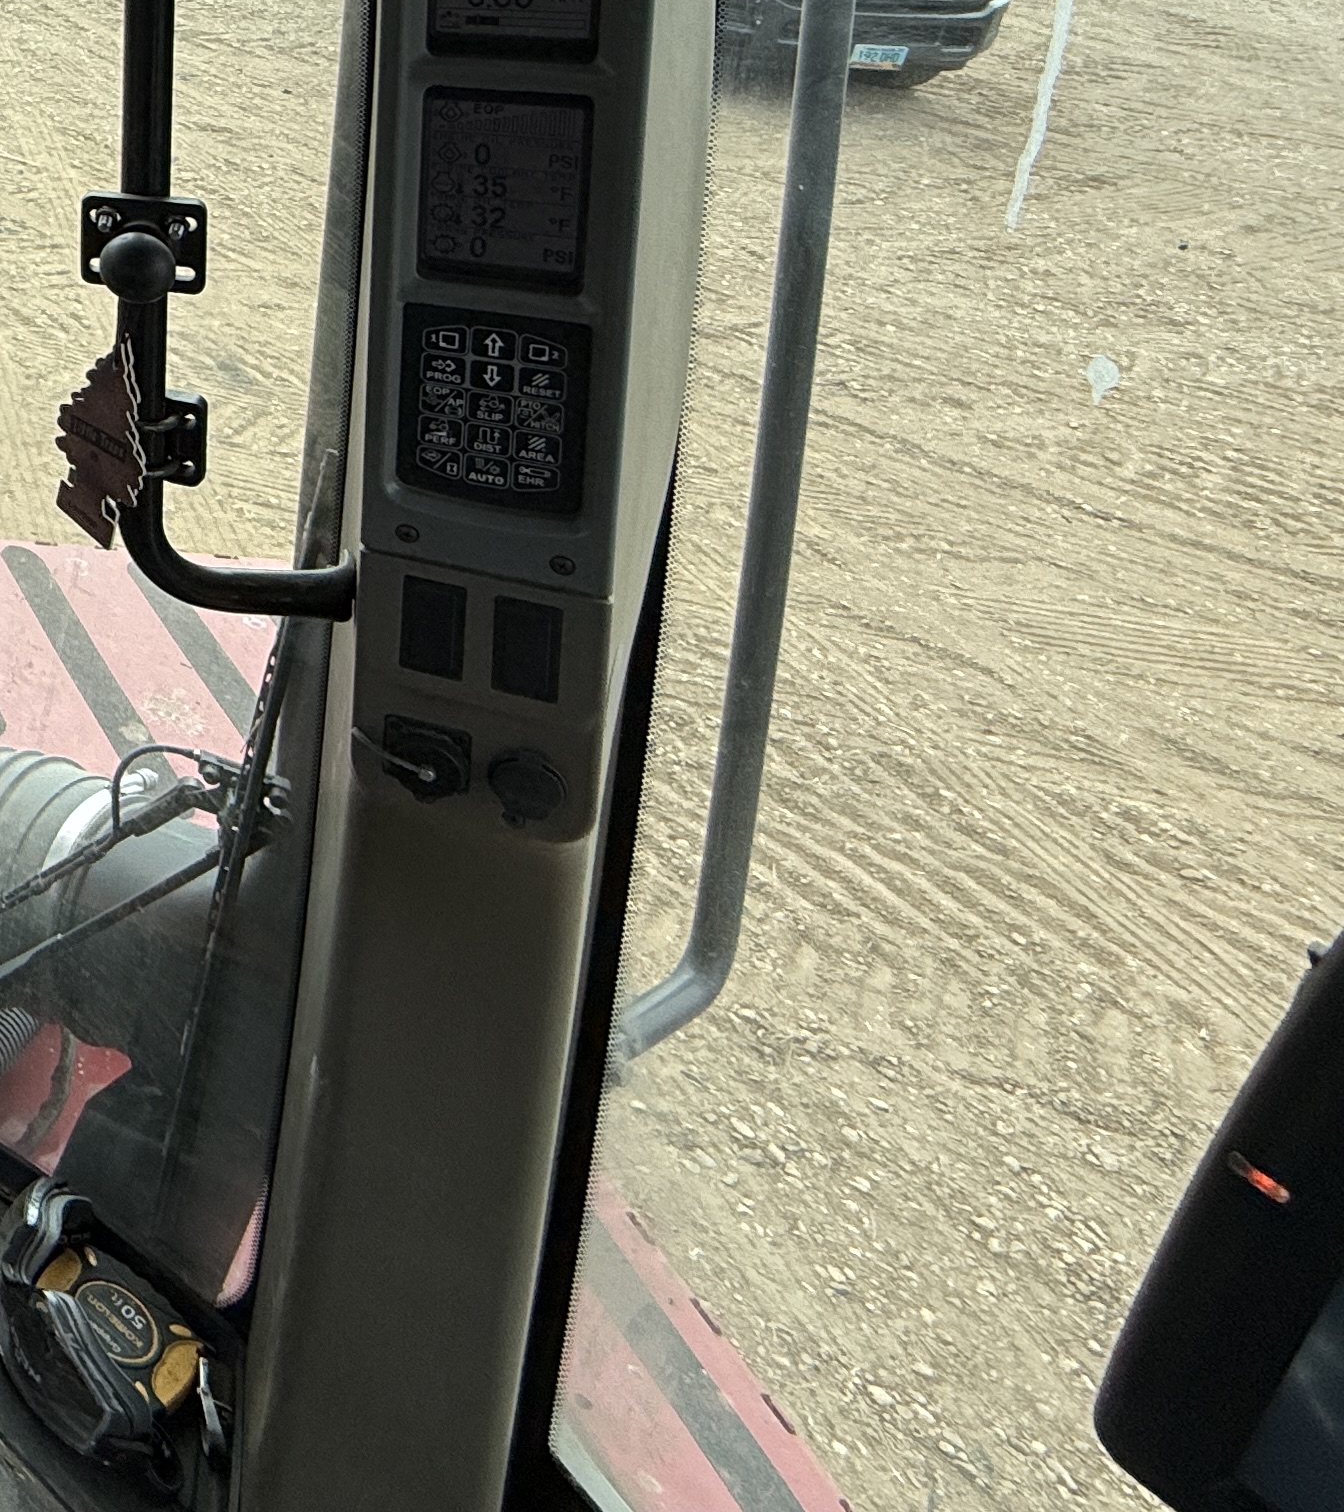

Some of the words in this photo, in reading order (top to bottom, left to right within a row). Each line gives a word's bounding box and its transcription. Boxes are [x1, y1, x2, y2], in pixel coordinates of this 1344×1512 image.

[473, 103, 504, 115] EOP
[474, 143, 491, 166] 0
[548, 153, 580, 171] PSI
[472, 174, 508, 198] 35
[471, 205, 507, 229] 32
[470, 236, 487, 258] 0
[543, 248, 574, 265] PSI
[430, 334, 437, 343] 1
[551, 350, 560, 360] 2
[426, 370, 462, 383] PROG
[523, 385, 561, 398] RESET
[447, 398, 464, 407] AP
[520, 400, 541, 410] PTO
[476, 410, 504, 421] SLIP
[530, 420, 560, 432] HITCH
[425, 434, 457, 446] PERF
[473, 442, 502, 454] DIST
[518, 450, 555, 463] AREA
[468, 472, 505, 486] AUTO
[518, 475, 546, 487] EHR
[121, 1304, 147, 1332] 50
